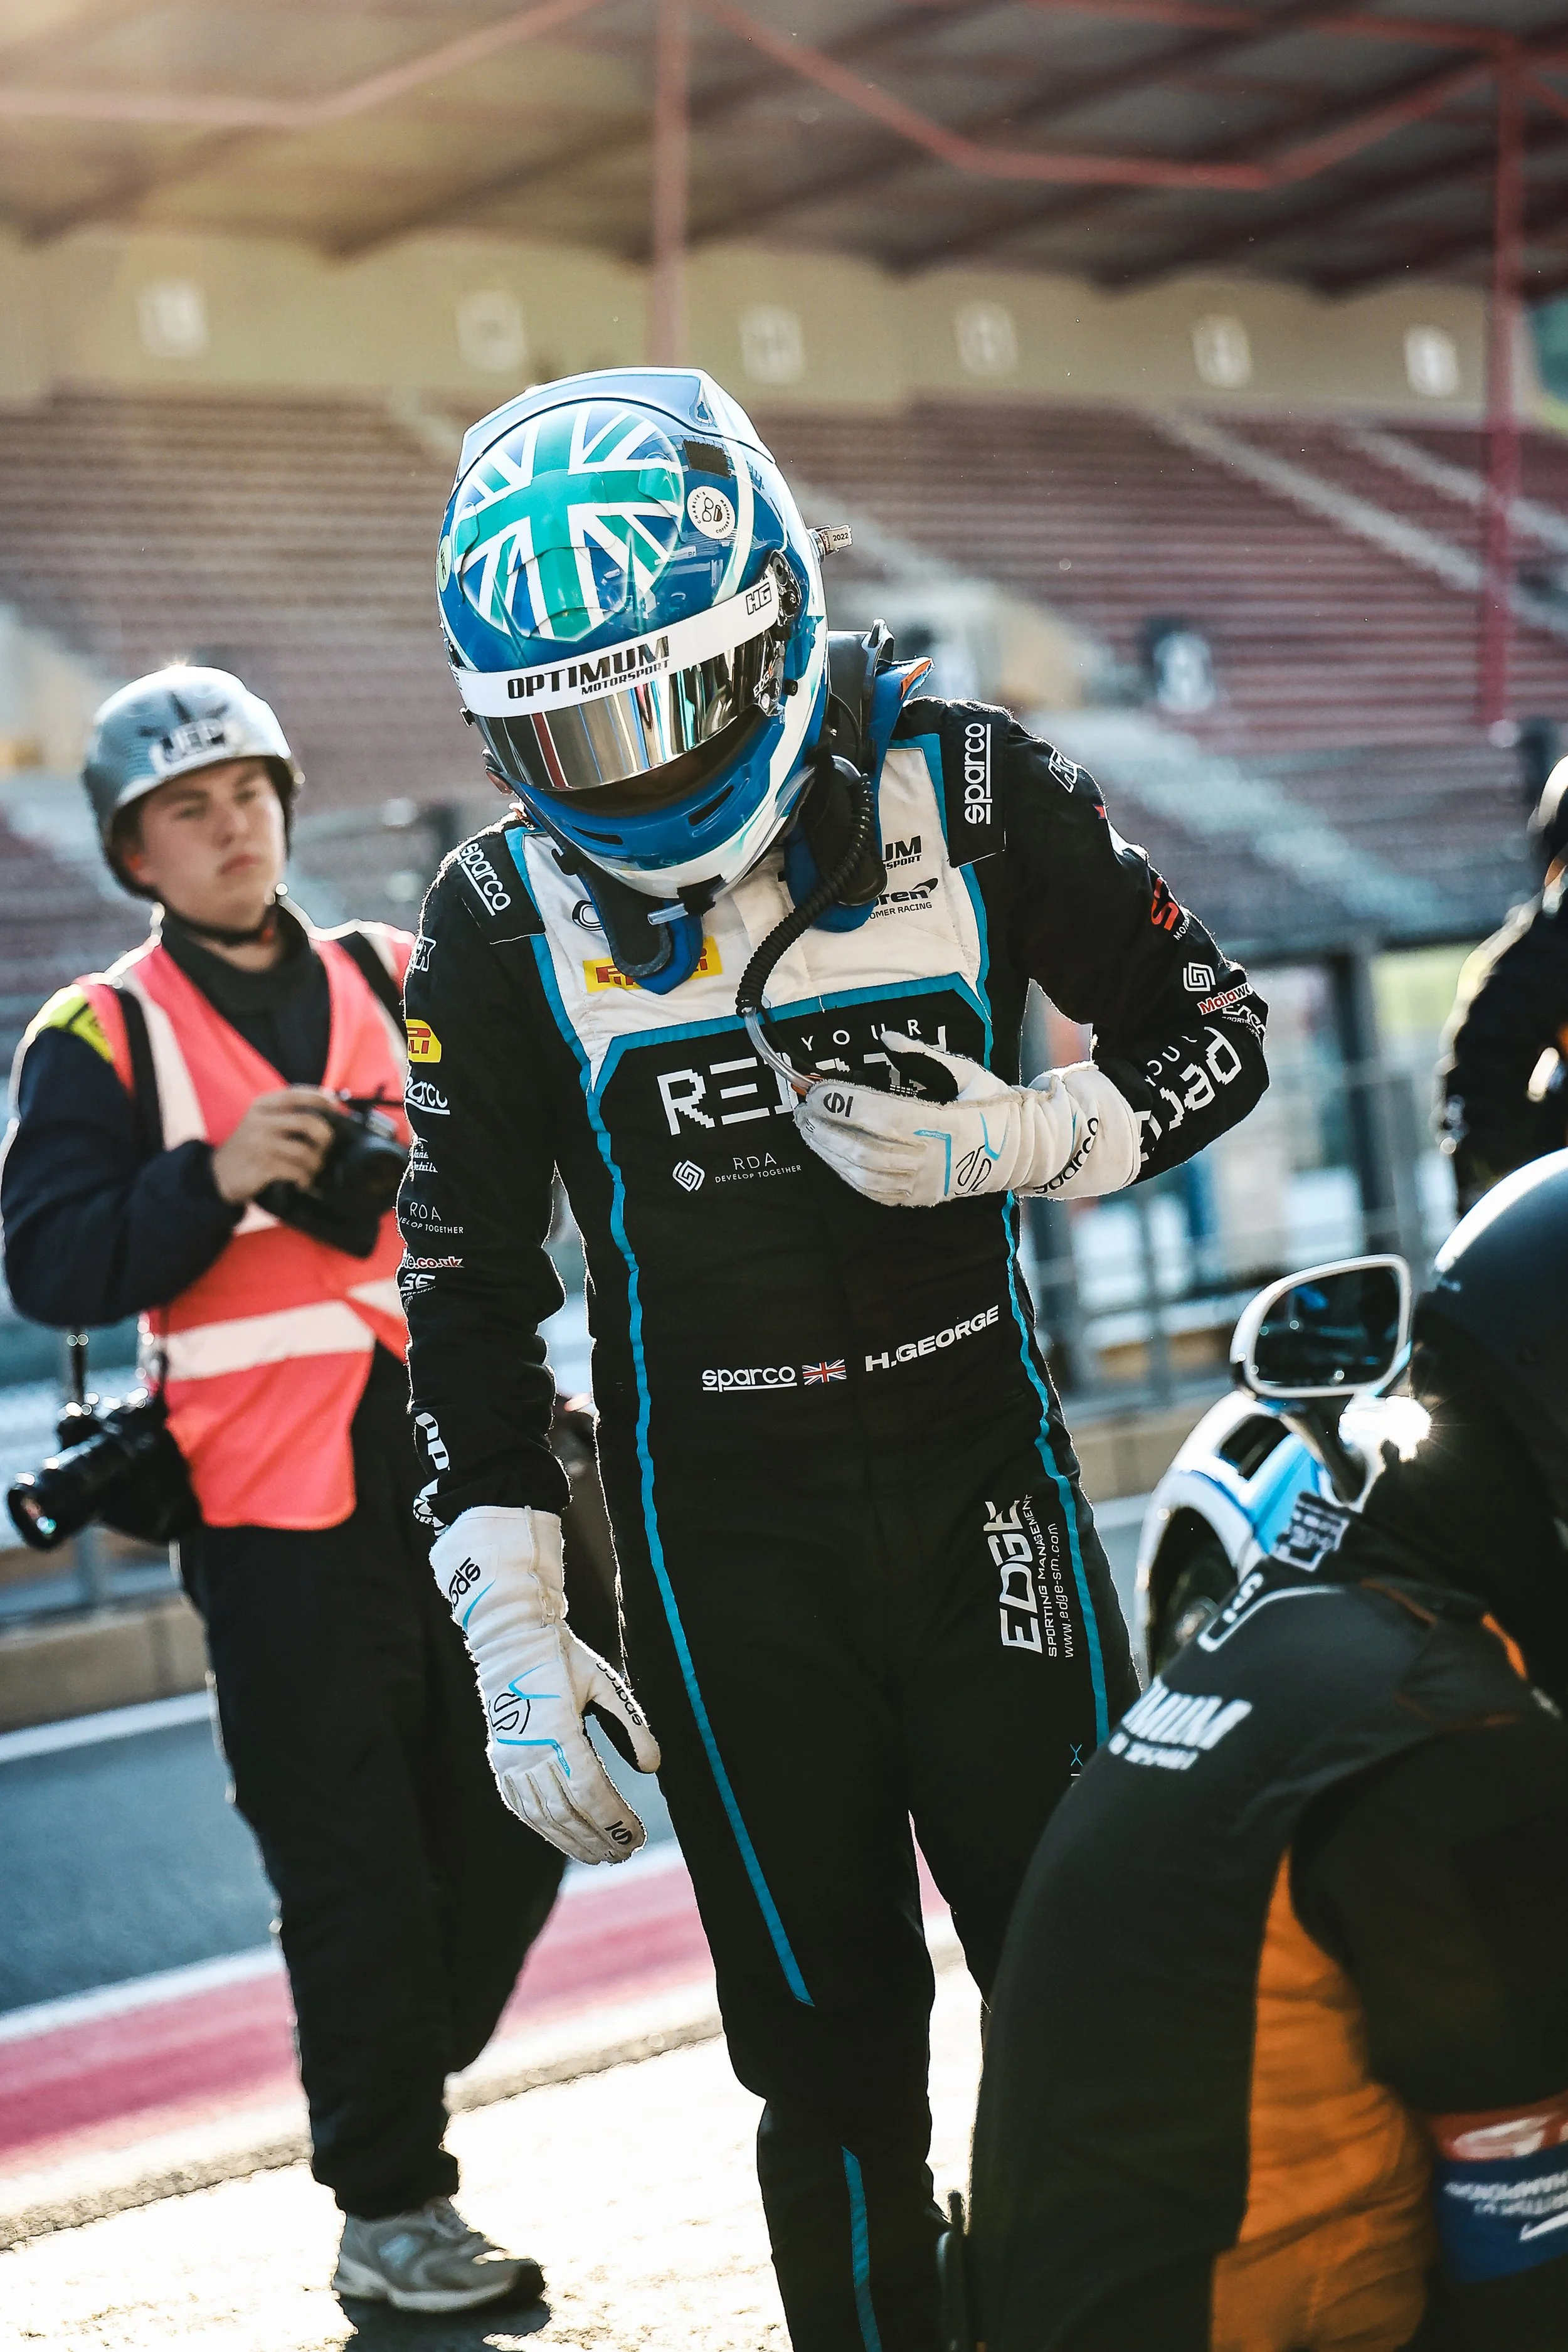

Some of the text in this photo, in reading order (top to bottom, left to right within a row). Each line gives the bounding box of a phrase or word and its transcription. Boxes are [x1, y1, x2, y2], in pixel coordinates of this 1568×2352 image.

[832, 532, 849, 542] 2022
[745, 581, 772, 616] HG
[507, 635, 670, 701] OPTIMUM
[581, 659, 669, 695] MOTORSPORT
[964, 723, 993, 825] sparco
[458, 842, 512, 916] sparco
[884, 854, 922, 870] SPORT
[869, 901, 933, 919] OMER RACING
[801, 1019, 922, 1051] YOUR
[714, 1164, 802, 1184] DEVELOP TOGETHER
[733, 1152, 777, 1170] RDA
[425, 1224, 464, 1234] TOGETHER
[702, 1304, 999, 1392] sparco H.GEORGE
[983, 1500, 1043, 1654] EDGE
[1022, 1494, 1057, 1658] SPORTING MANAGEMENT
[1047, 1523, 1074, 1658] www.edge-sm.com
